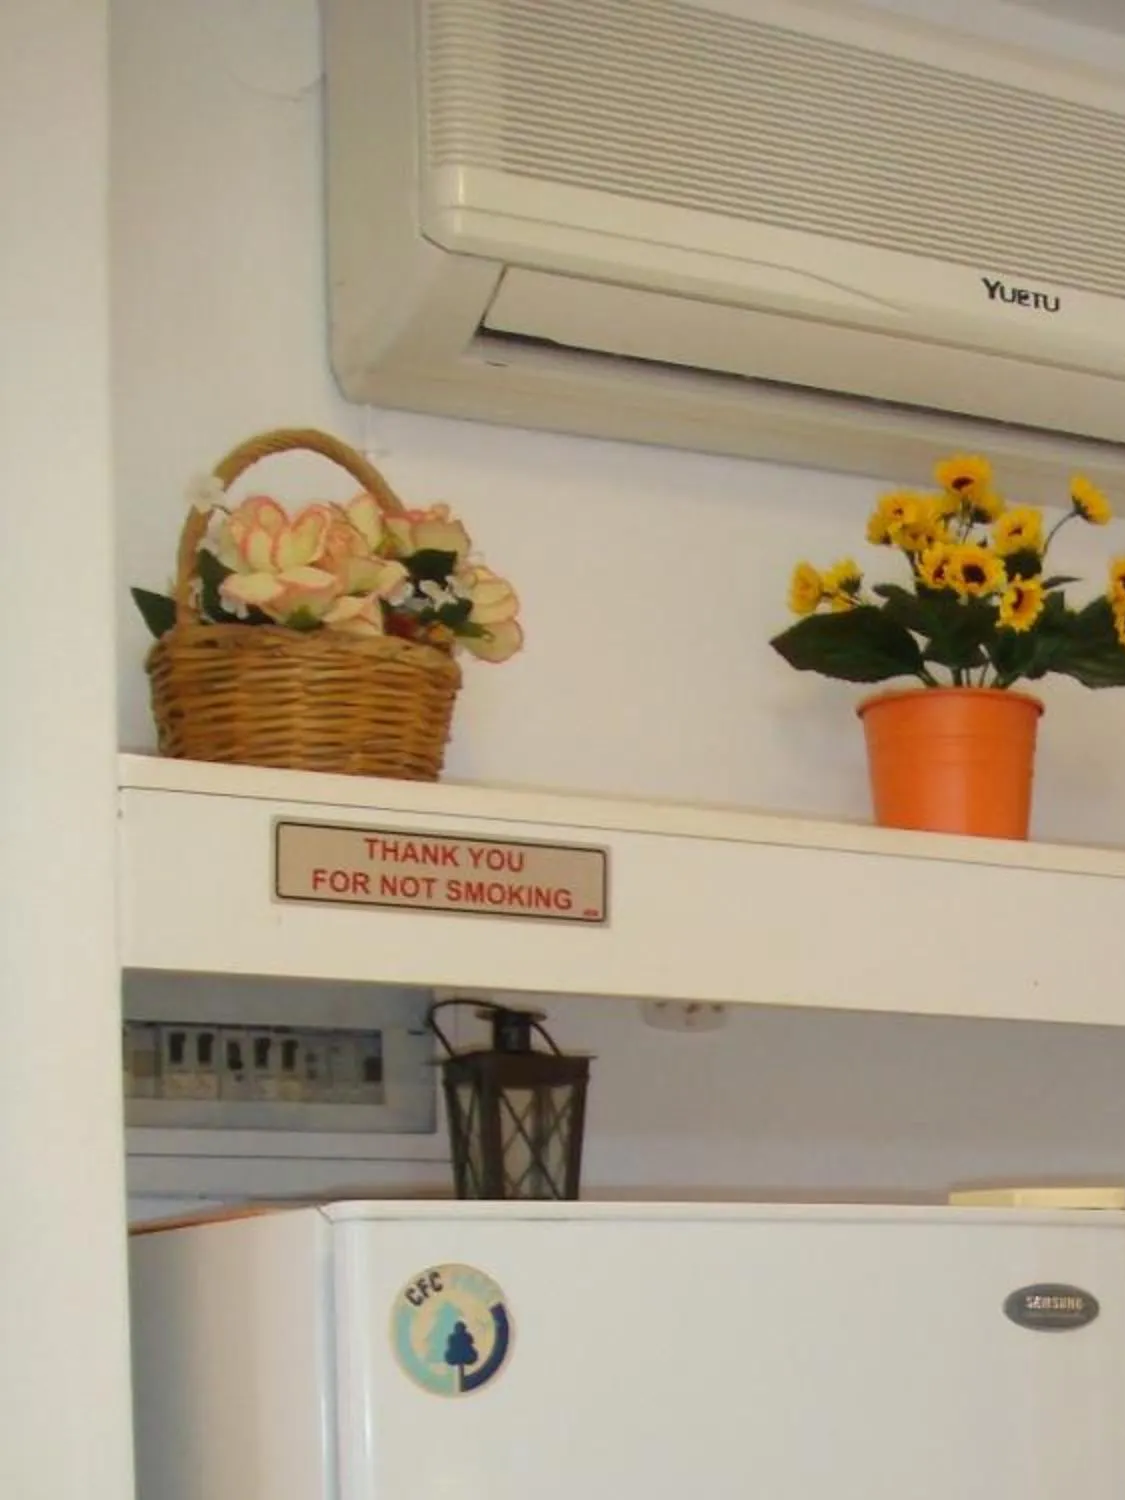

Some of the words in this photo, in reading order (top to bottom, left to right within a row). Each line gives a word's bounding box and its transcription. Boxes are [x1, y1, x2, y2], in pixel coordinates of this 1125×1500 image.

[363, 838, 459, 867] THANK
[468, 848, 524, 872] YOU
[312, 869, 371, 895] FOR
[381, 874, 437, 899] NOT
[446, 880, 573, 910] SMOKING
[404, 1271, 444, 1306] CFC
